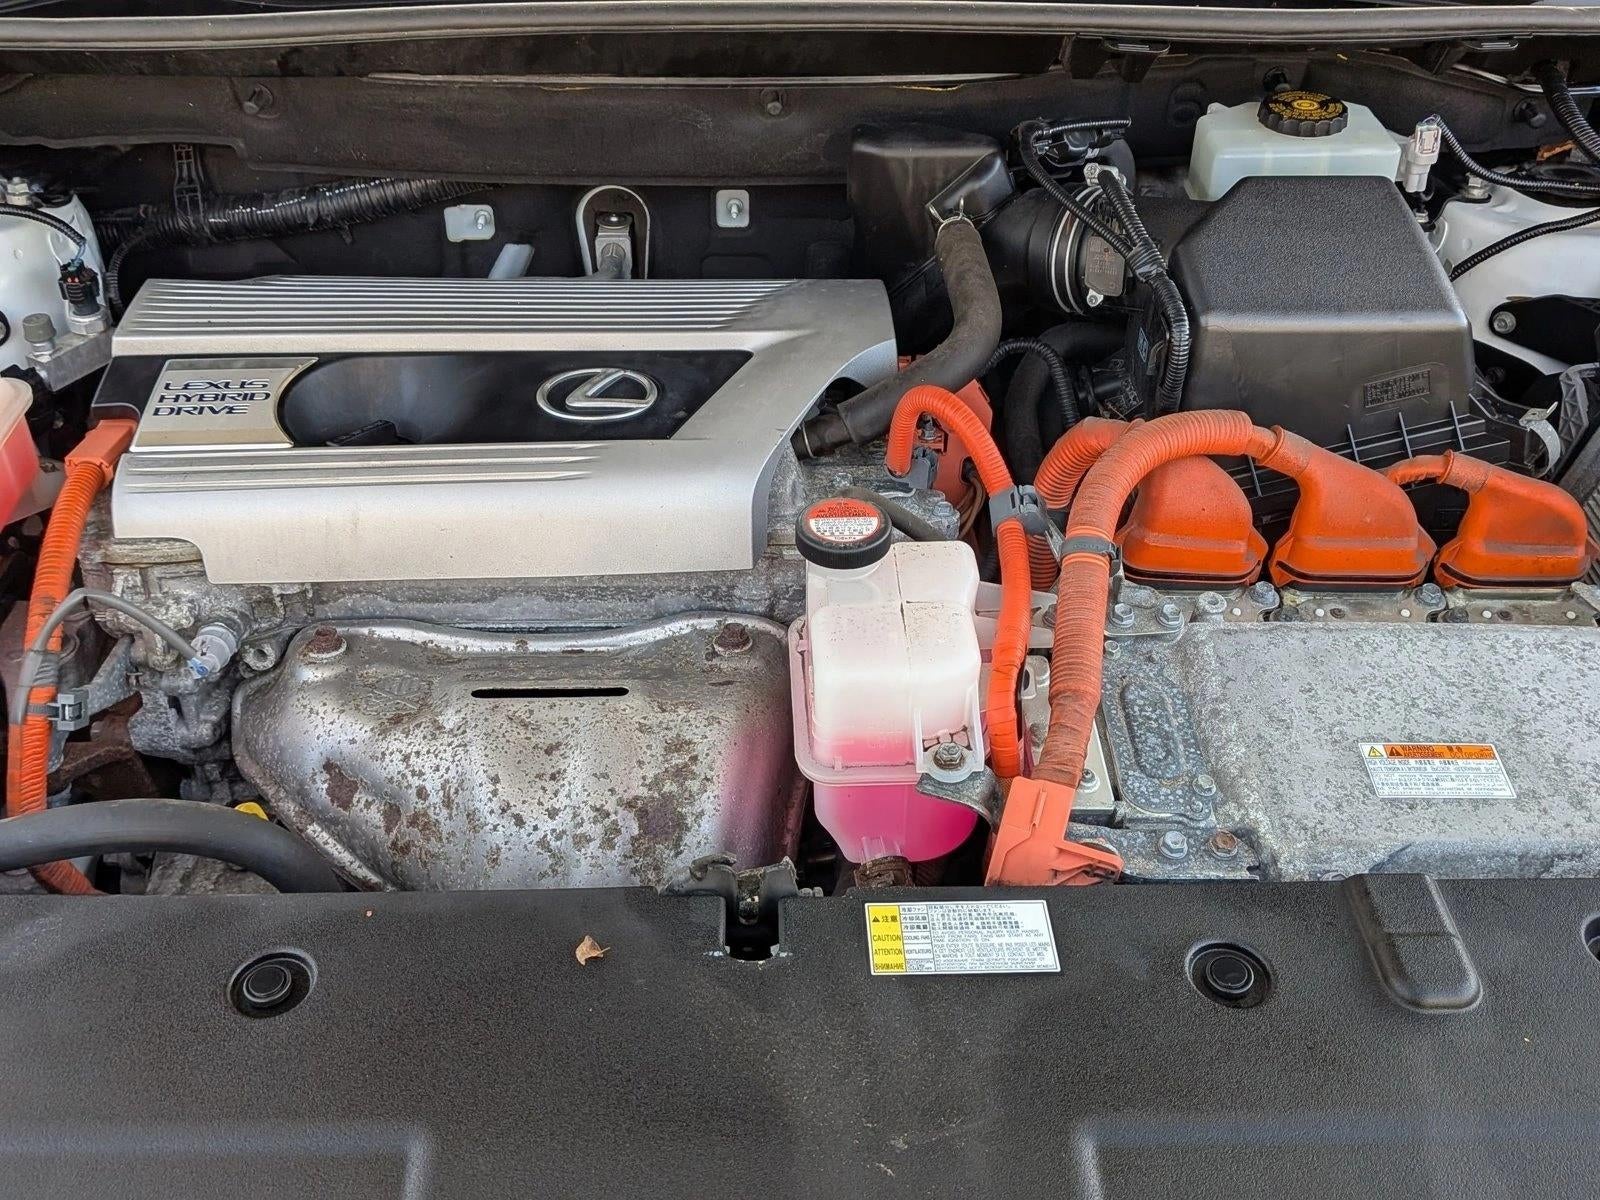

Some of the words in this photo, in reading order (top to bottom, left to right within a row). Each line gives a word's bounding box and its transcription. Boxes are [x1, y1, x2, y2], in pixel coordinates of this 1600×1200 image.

[163, 380, 269, 390] LEXUS
[158, 391, 271, 403] HYBRID
[152, 404, 250, 416] DRIVE
[875, 948, 903, 956] ATTENTION
